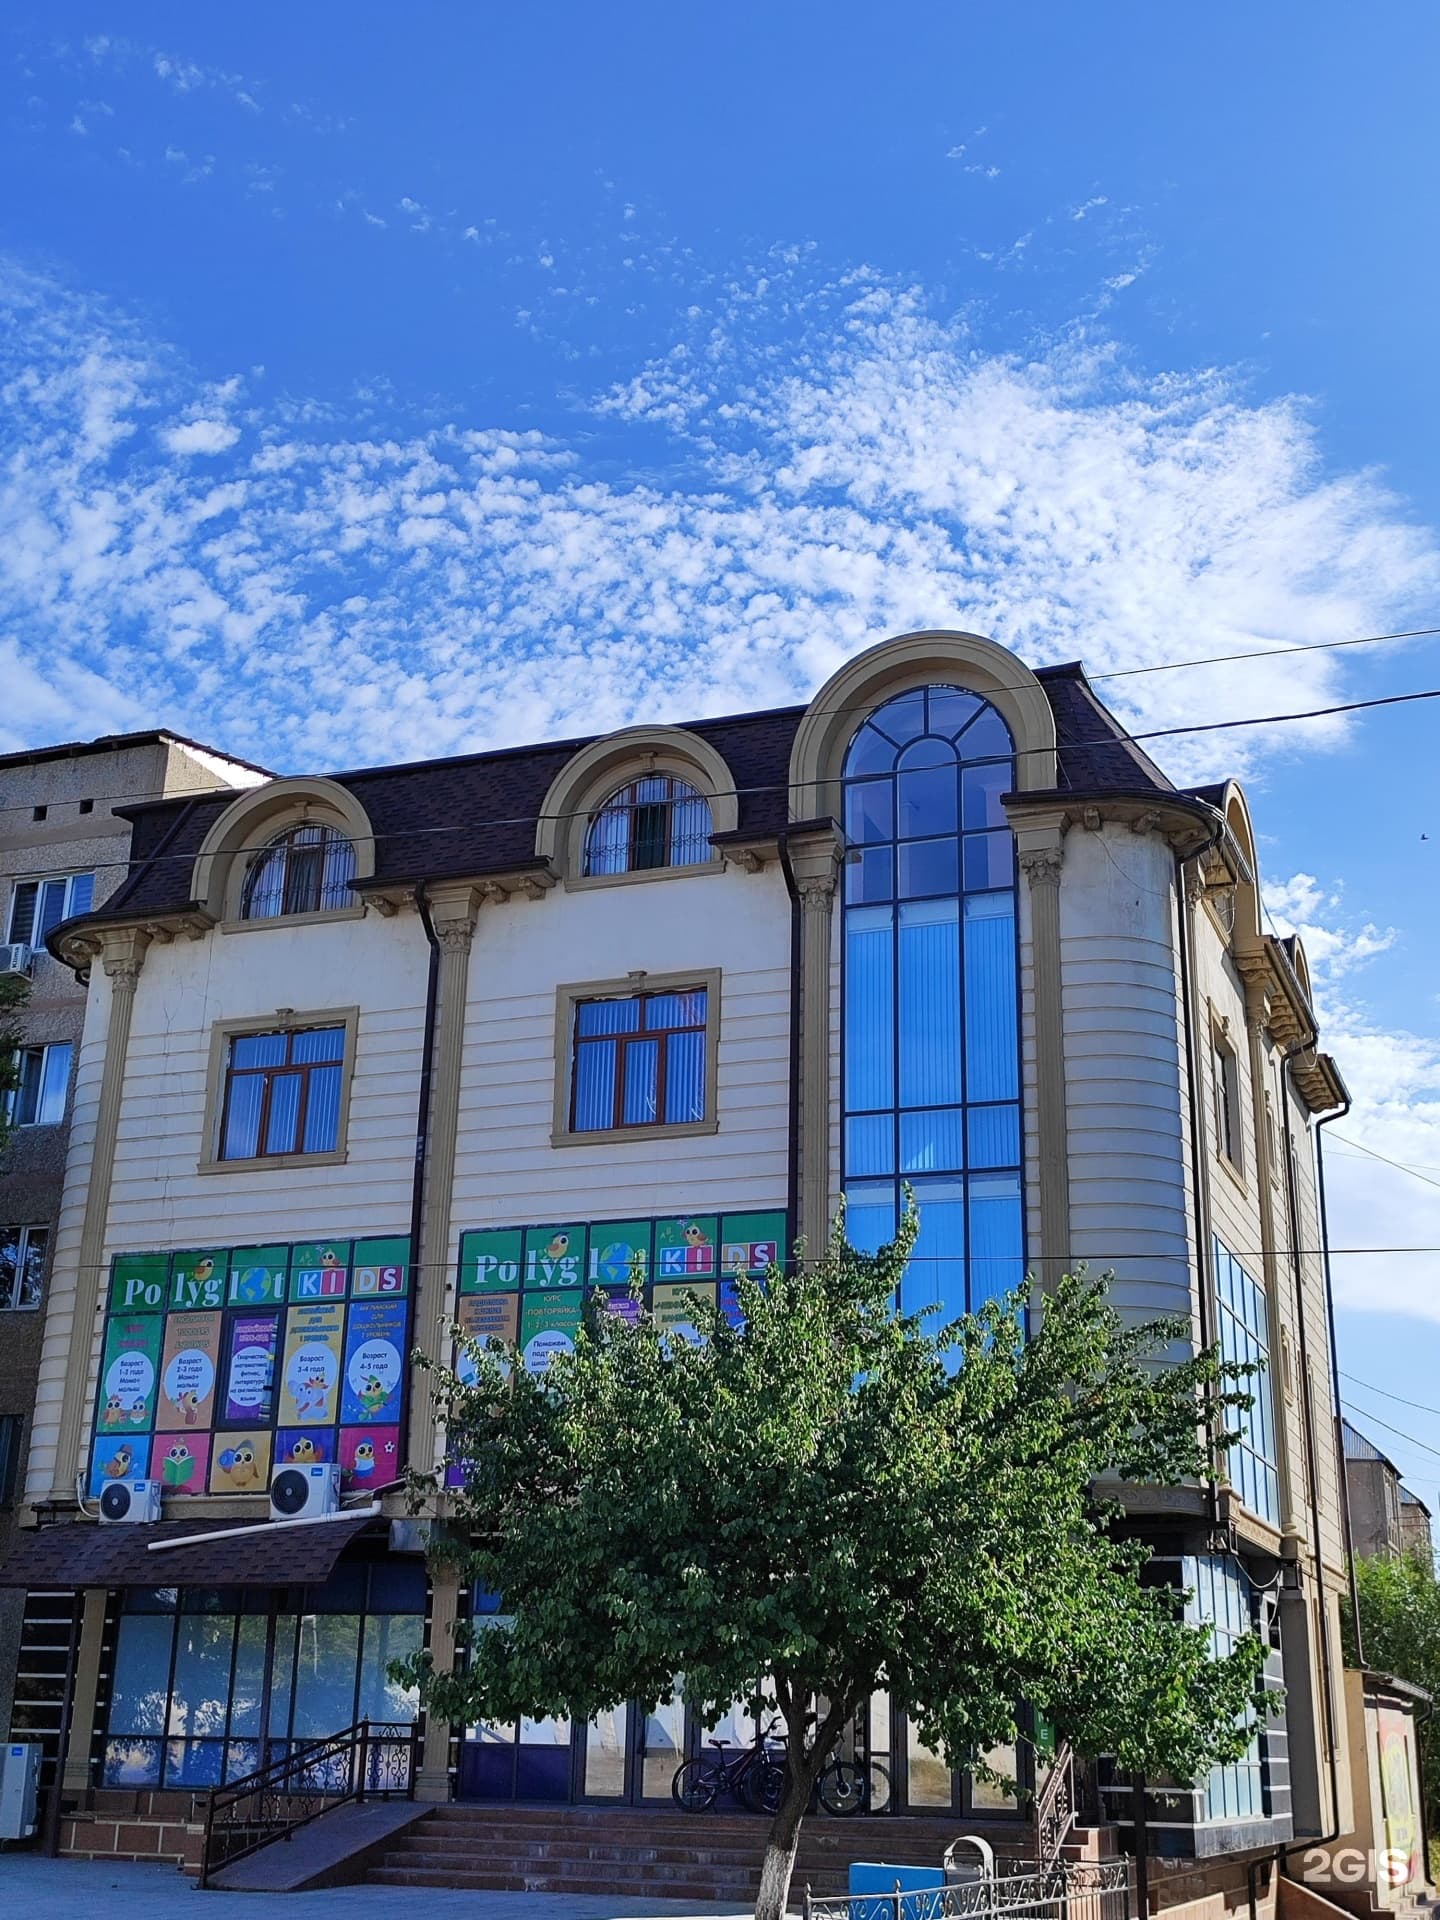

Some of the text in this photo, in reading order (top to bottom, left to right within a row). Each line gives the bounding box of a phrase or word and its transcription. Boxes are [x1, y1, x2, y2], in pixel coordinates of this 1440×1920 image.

[664, 1243, 771, 1273] KIDS
[301, 1266, 398, 1297] KIDS
[300, 1355, 325, 1363] Возраст
[362, 1352, 388, 1360] Возраст
[120, 1360, 144, 1368] Возраст
[178, 1358, 203, 1366] Возраст
[373, 1363, 389, 1371] года
